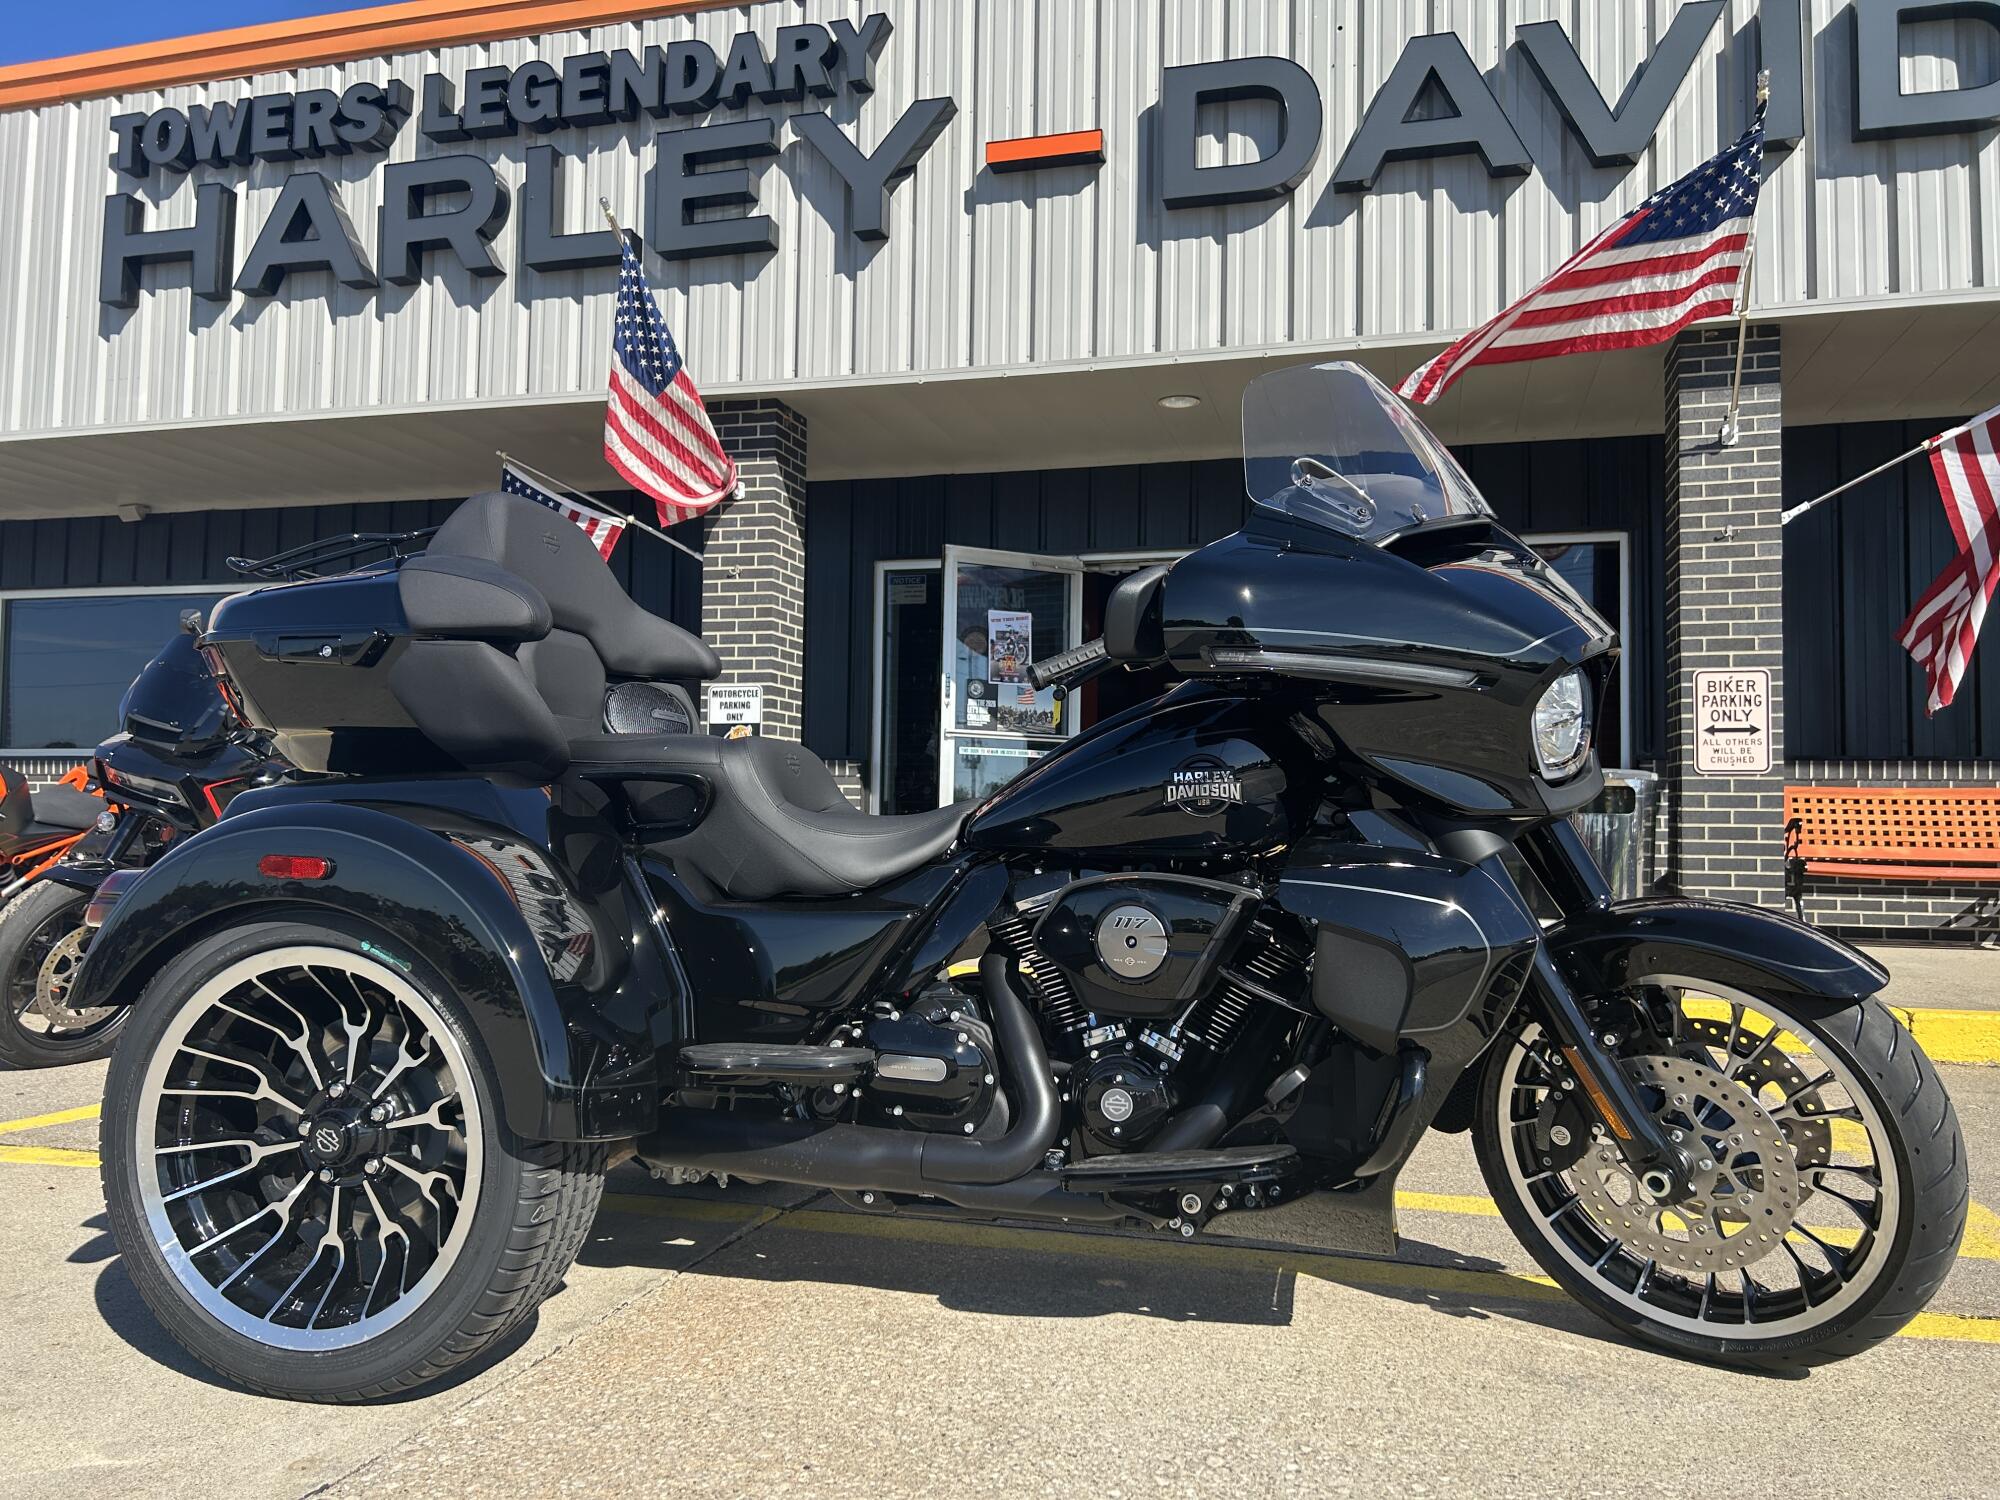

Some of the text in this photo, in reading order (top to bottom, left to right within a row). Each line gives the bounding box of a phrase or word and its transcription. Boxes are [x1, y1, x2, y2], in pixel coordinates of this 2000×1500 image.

[109, 12, 894, 178] TOWERS' LEGENDARY
[1707, 680, 1756, 693] BIKER
[712, 689, 759, 698] MOTORCYCLE
[720, 701, 751, 710] PARKING
[1702, 694, 1762, 708] PARKING
[726, 713, 744, 721] ONLY
[1710, 709, 1753, 722] ONLY
[1725, 738, 1763, 746] OTHERS
[1713, 747, 1752, 755] WILL BE
[1710, 756, 1755, 764] CRUSHED
[1167, 782, 1241, 802] DAVIDSON
[1113, 916, 1152, 929] 117
